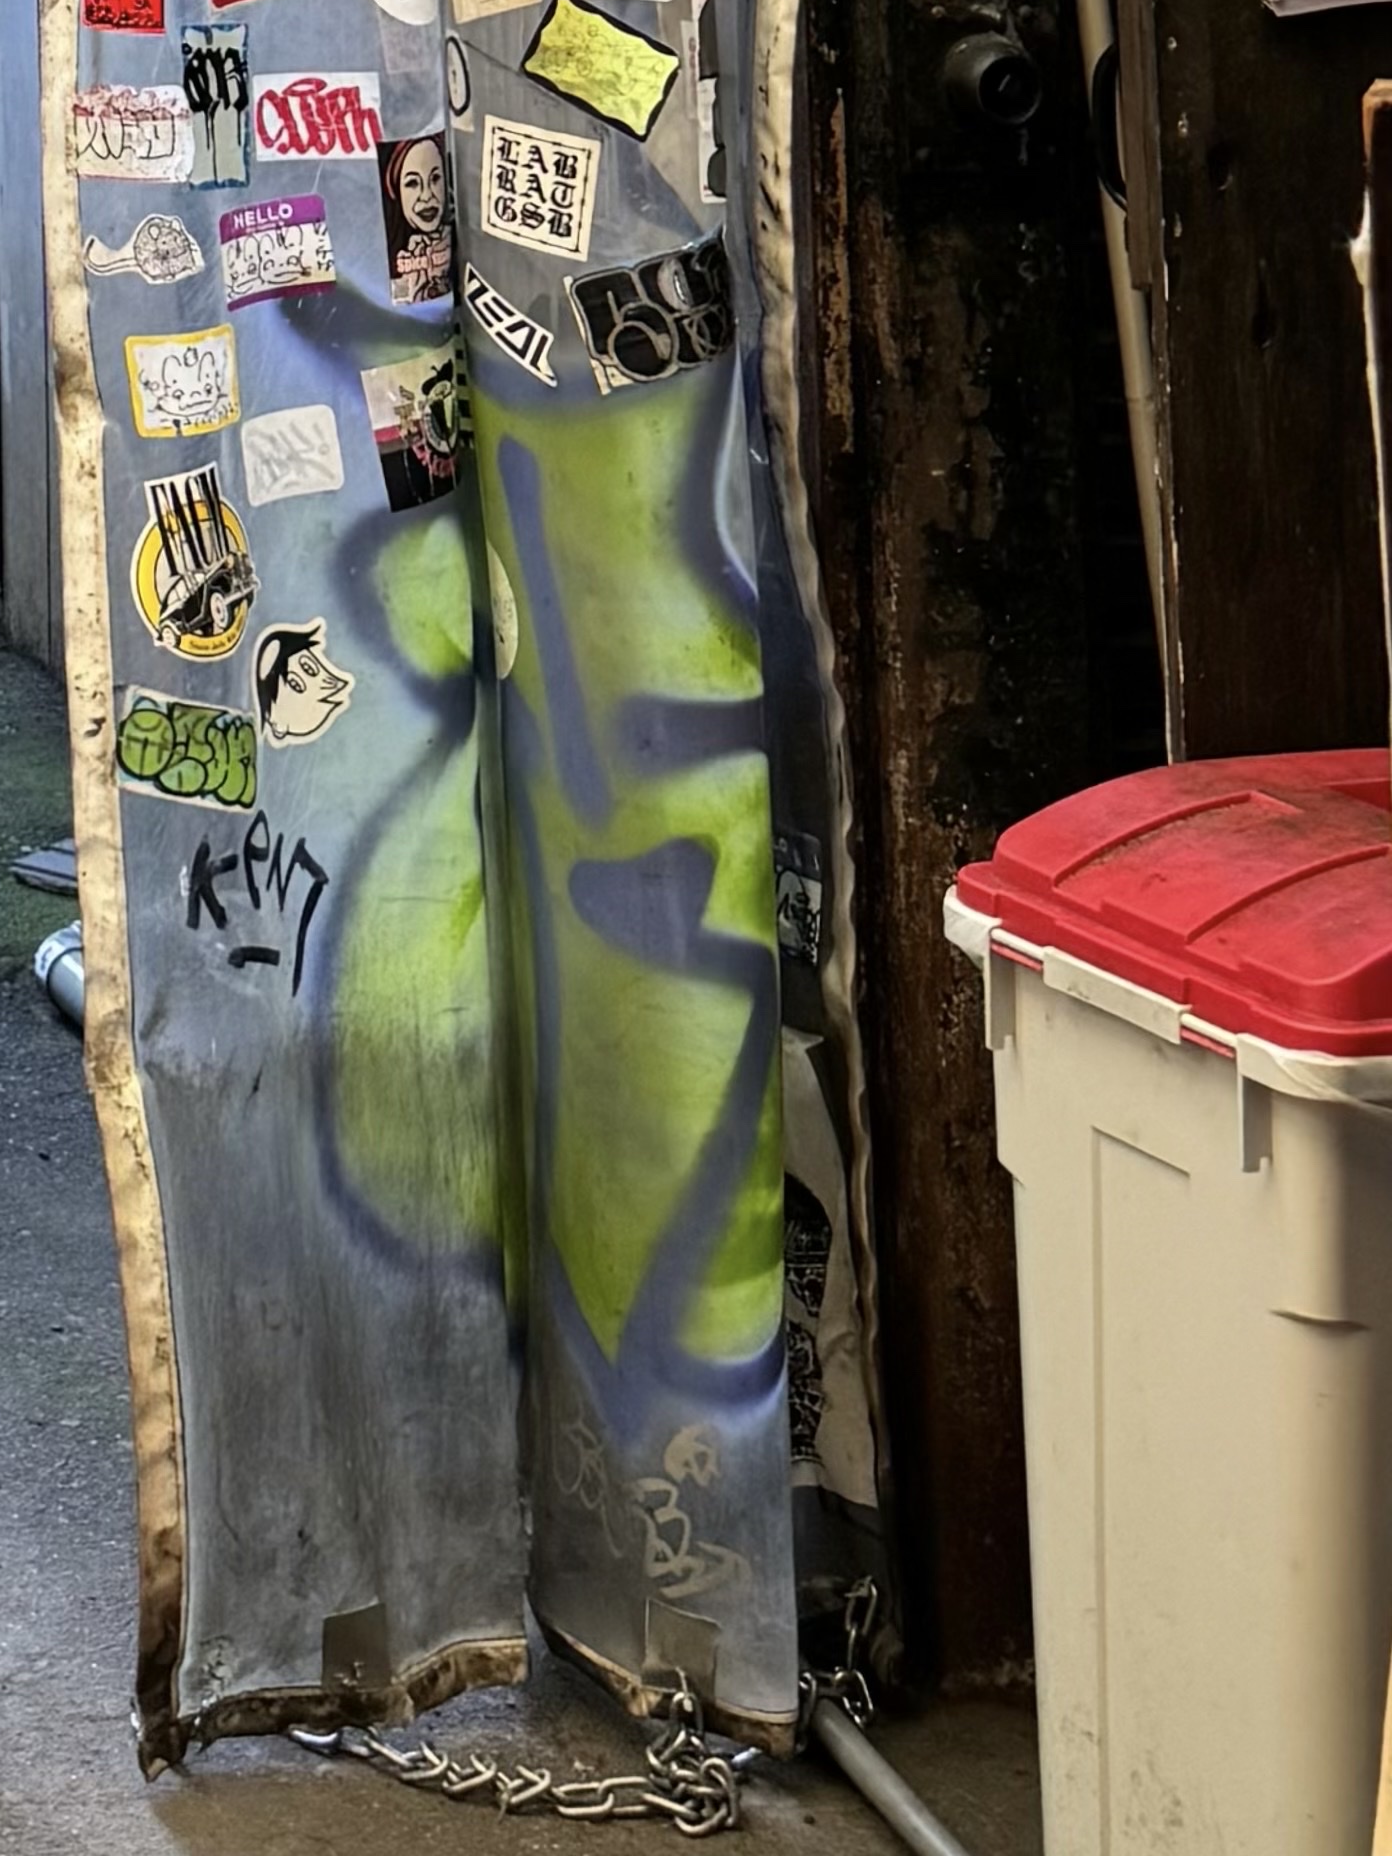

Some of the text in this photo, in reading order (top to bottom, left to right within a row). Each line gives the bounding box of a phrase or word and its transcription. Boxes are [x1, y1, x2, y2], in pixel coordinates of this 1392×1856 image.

[495, 134, 586, 178] LAB
[492, 164, 583, 208] RAT
[232, 202, 294, 231] HELLO
